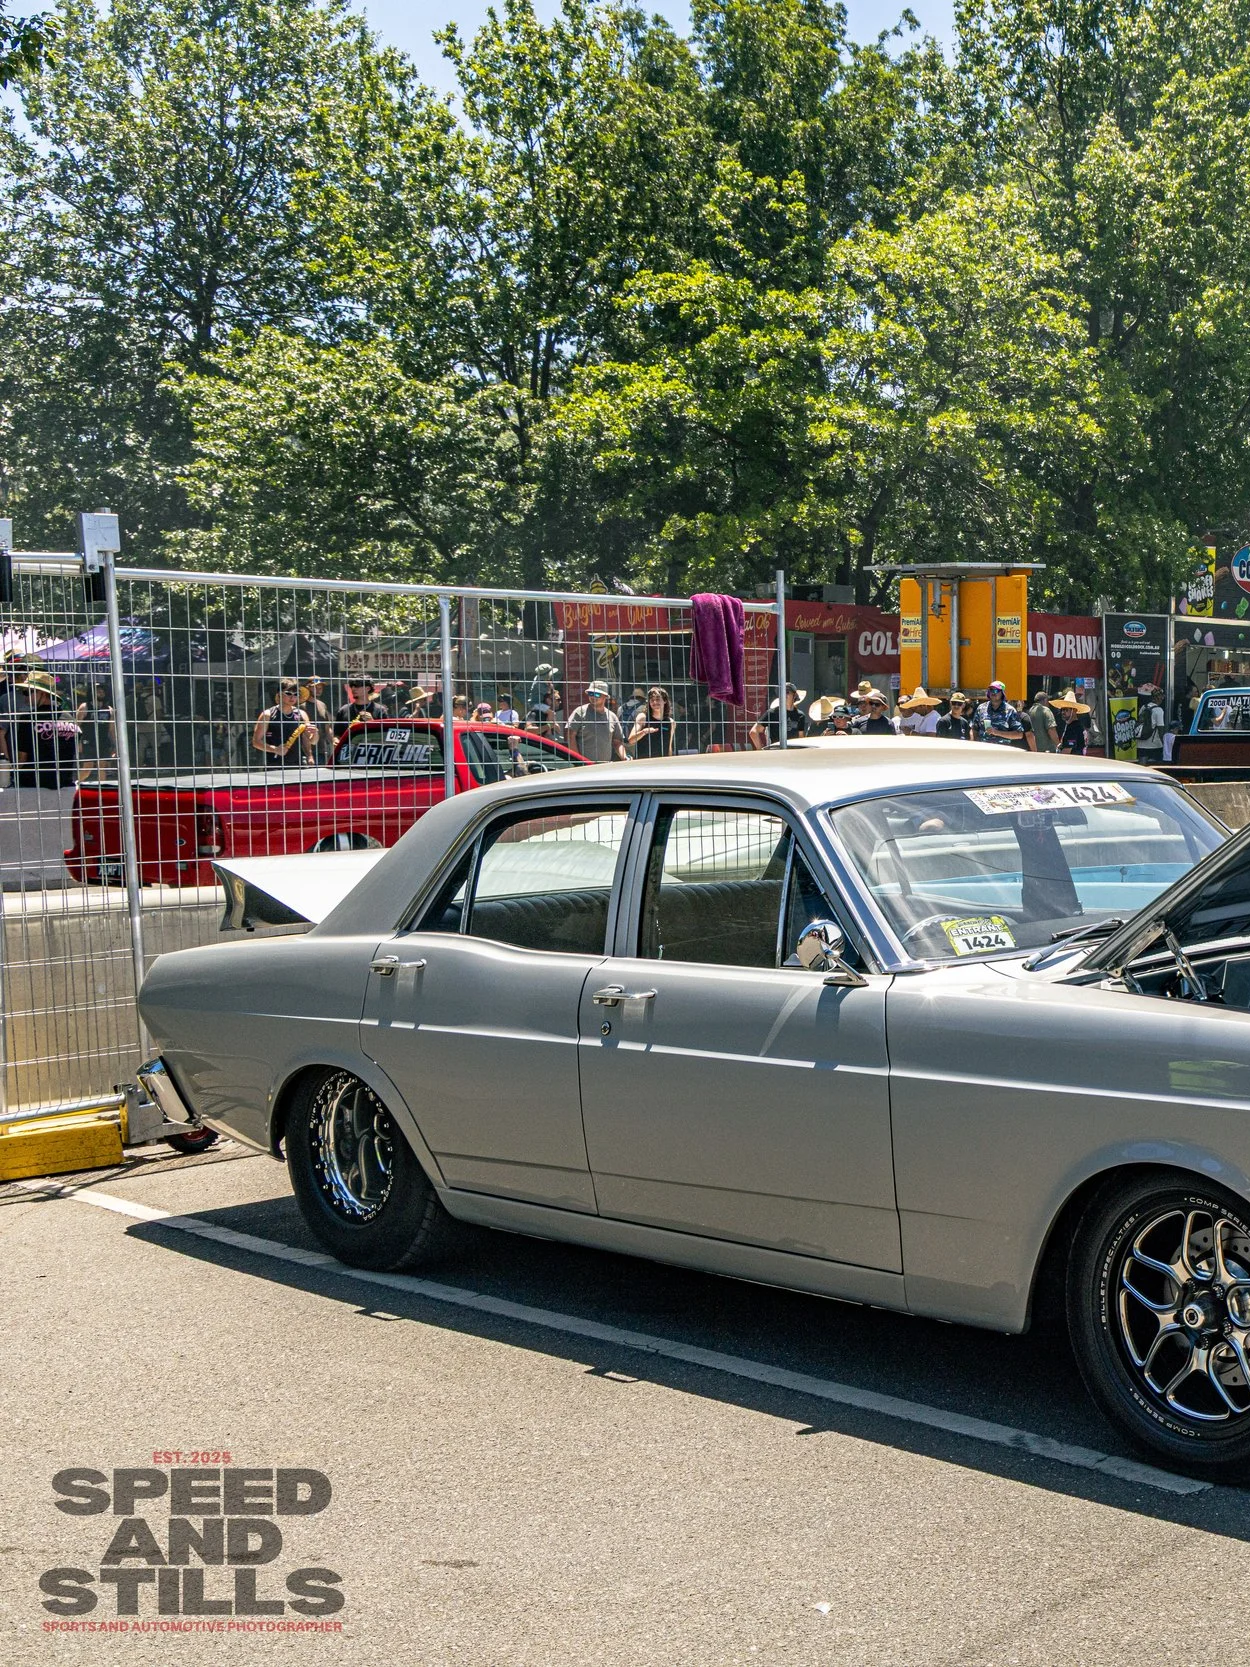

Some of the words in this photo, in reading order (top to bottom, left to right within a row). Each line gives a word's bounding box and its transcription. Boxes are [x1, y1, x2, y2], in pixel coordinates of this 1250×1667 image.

[1006, 627, 1020, 637] Hire
[858, 631, 900, 656] COL
[1027, 631, 1047, 657] LD
[1057, 786, 1117, 803] 1424
[950, 924, 1003, 937] ENTRANT
[962, 935, 1006, 950] 1424
[1189, 1197, 1219, 1209] COMP
[1103, 1216, 1135, 1278] SPECIALTIES
